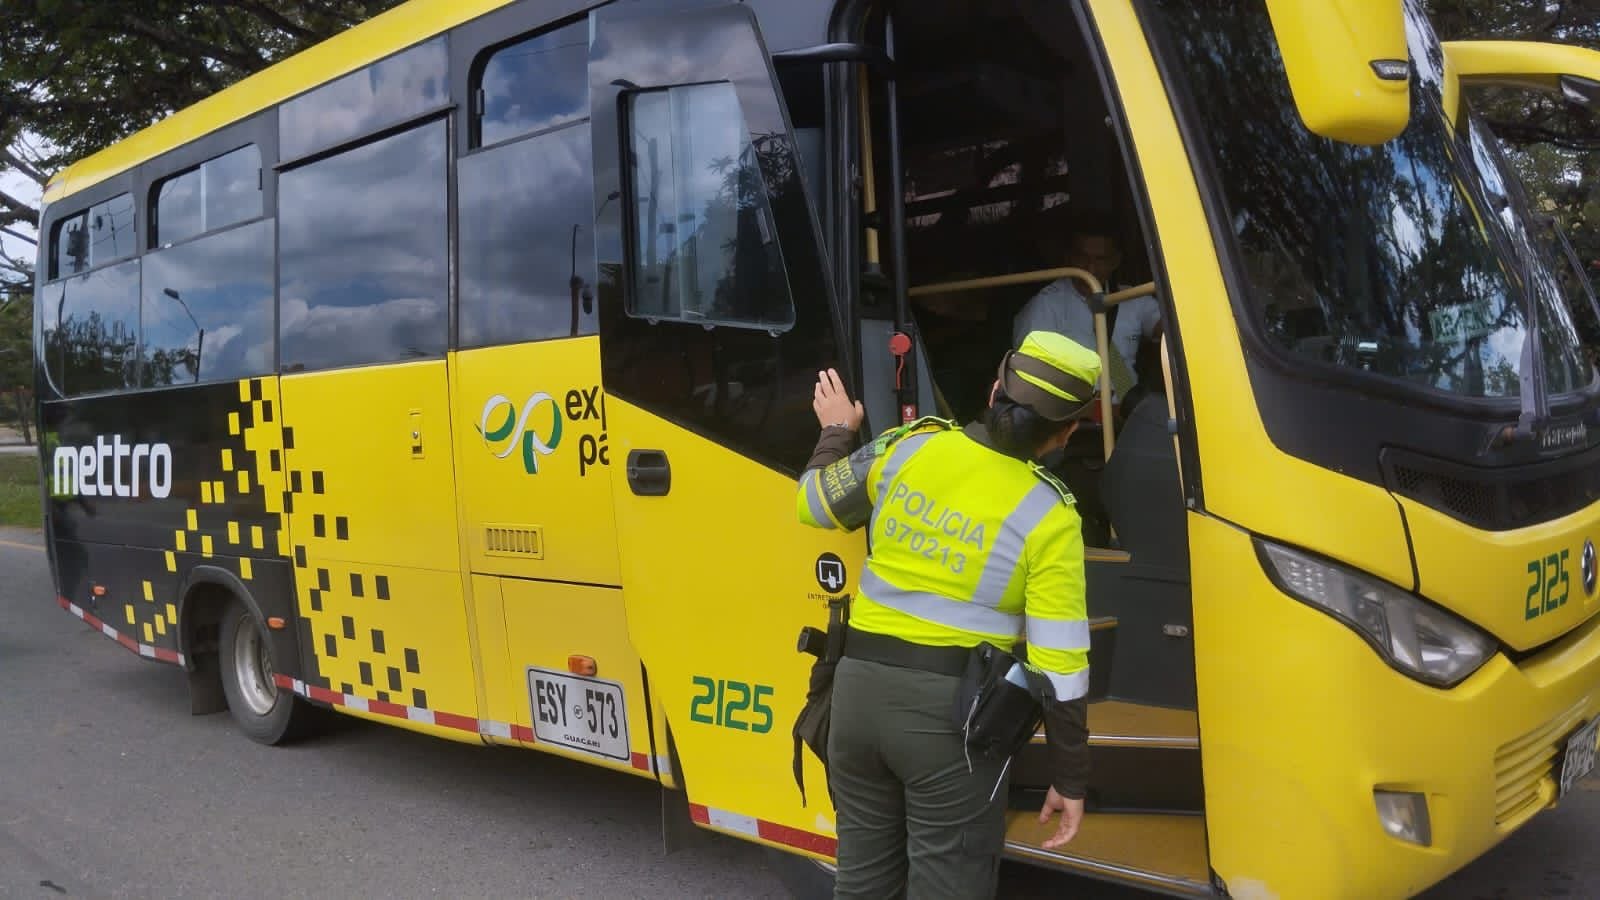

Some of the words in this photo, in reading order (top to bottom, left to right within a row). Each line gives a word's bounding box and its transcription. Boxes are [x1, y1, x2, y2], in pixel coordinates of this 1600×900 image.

[565, 385, 607, 430] ex
[53, 434, 172, 498] mettro
[891, 483, 985, 550] POLICIA
[885, 518, 967, 574] 970213
[1525, 549, 1569, 621] 2125
[535, 680, 568, 727] ESY
[586, 687, 619, 739] 573
[690, 676, 774, 734] 2125
[563, 734, 601, 748] GUACARI
